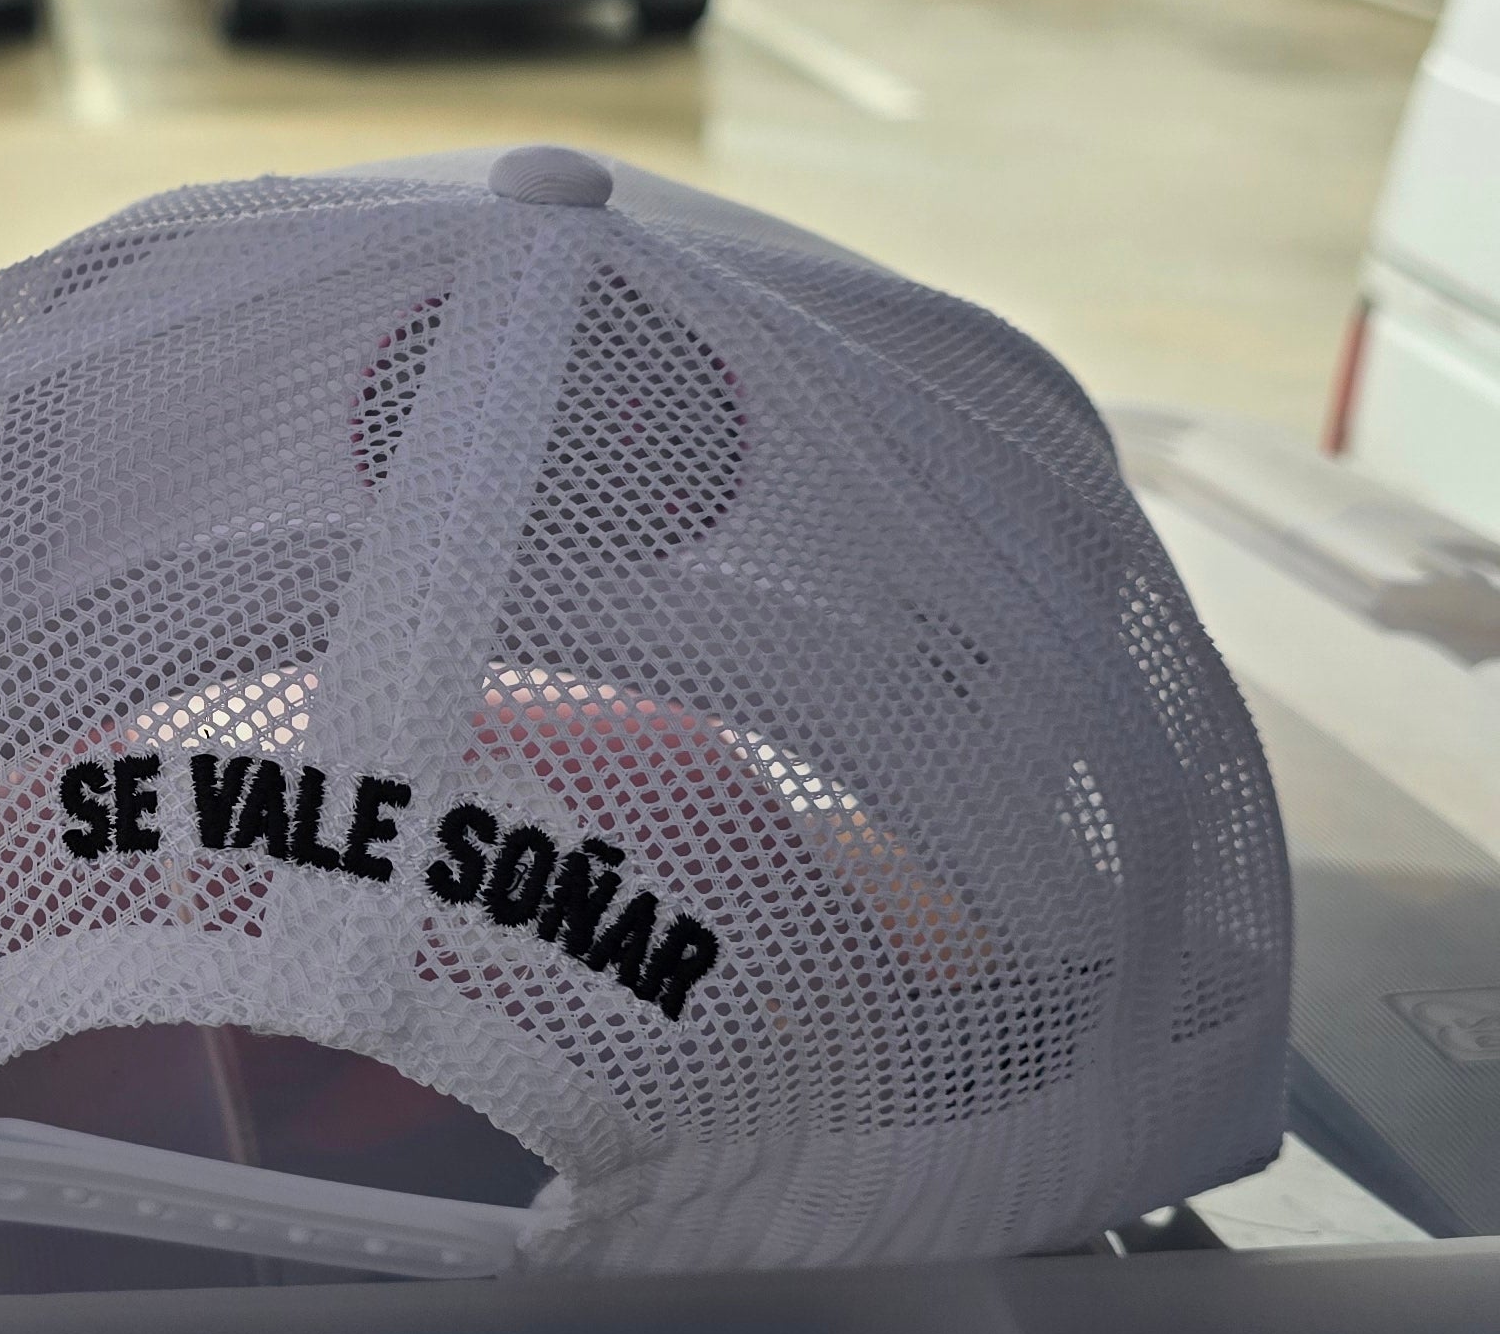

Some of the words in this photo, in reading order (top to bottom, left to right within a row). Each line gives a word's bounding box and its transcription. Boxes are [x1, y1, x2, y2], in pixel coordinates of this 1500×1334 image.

[58, 753, 162, 860] SE
[189, 752, 414, 883] VALE
[422, 800, 720, 1022] SOÑAR
